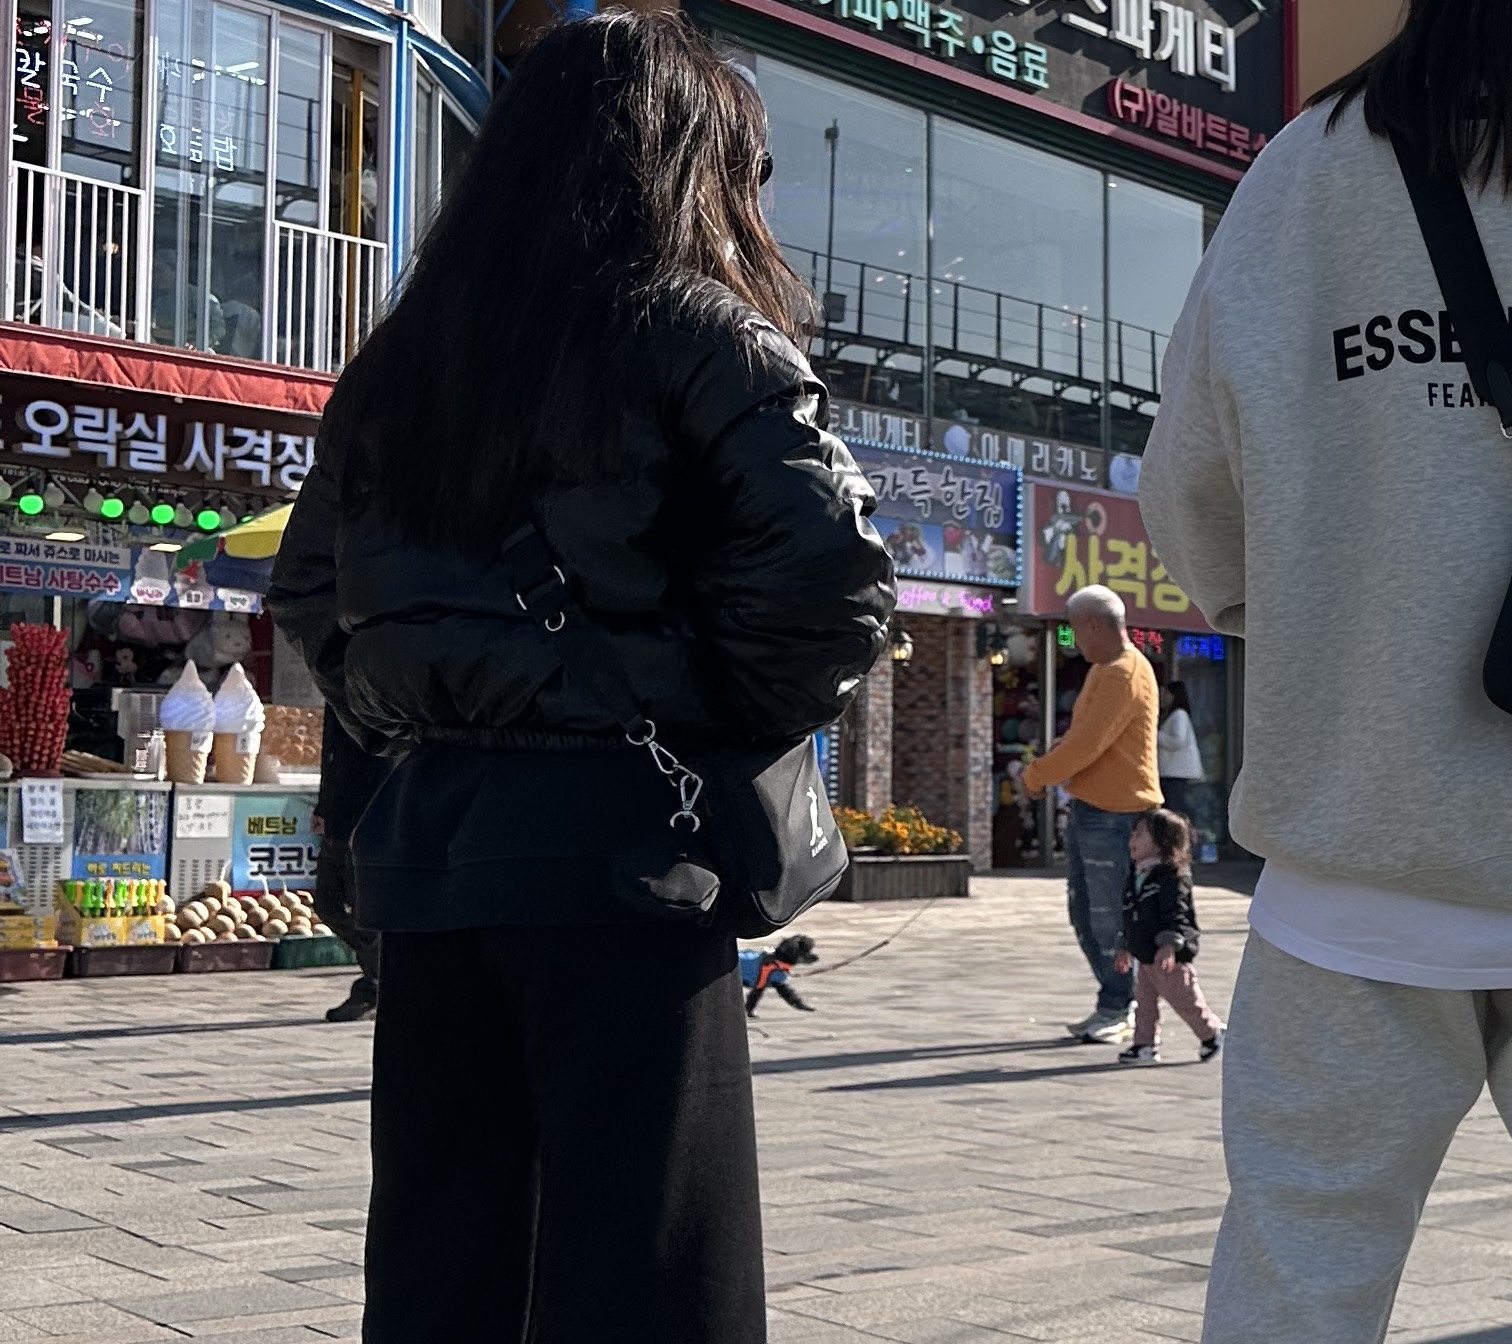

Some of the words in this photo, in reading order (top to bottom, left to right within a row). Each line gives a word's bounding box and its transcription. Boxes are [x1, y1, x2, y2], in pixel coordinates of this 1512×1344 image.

[985, 29, 1049, 89] 음료
[1427, 382, 1494, 408] FEA
[20, 399, 168, 472] 오락실
[182, 421, 317, 491] 사격장
[981, 431, 1099, 482] 아메리카노
[247, 815, 299, 836] 베트남
